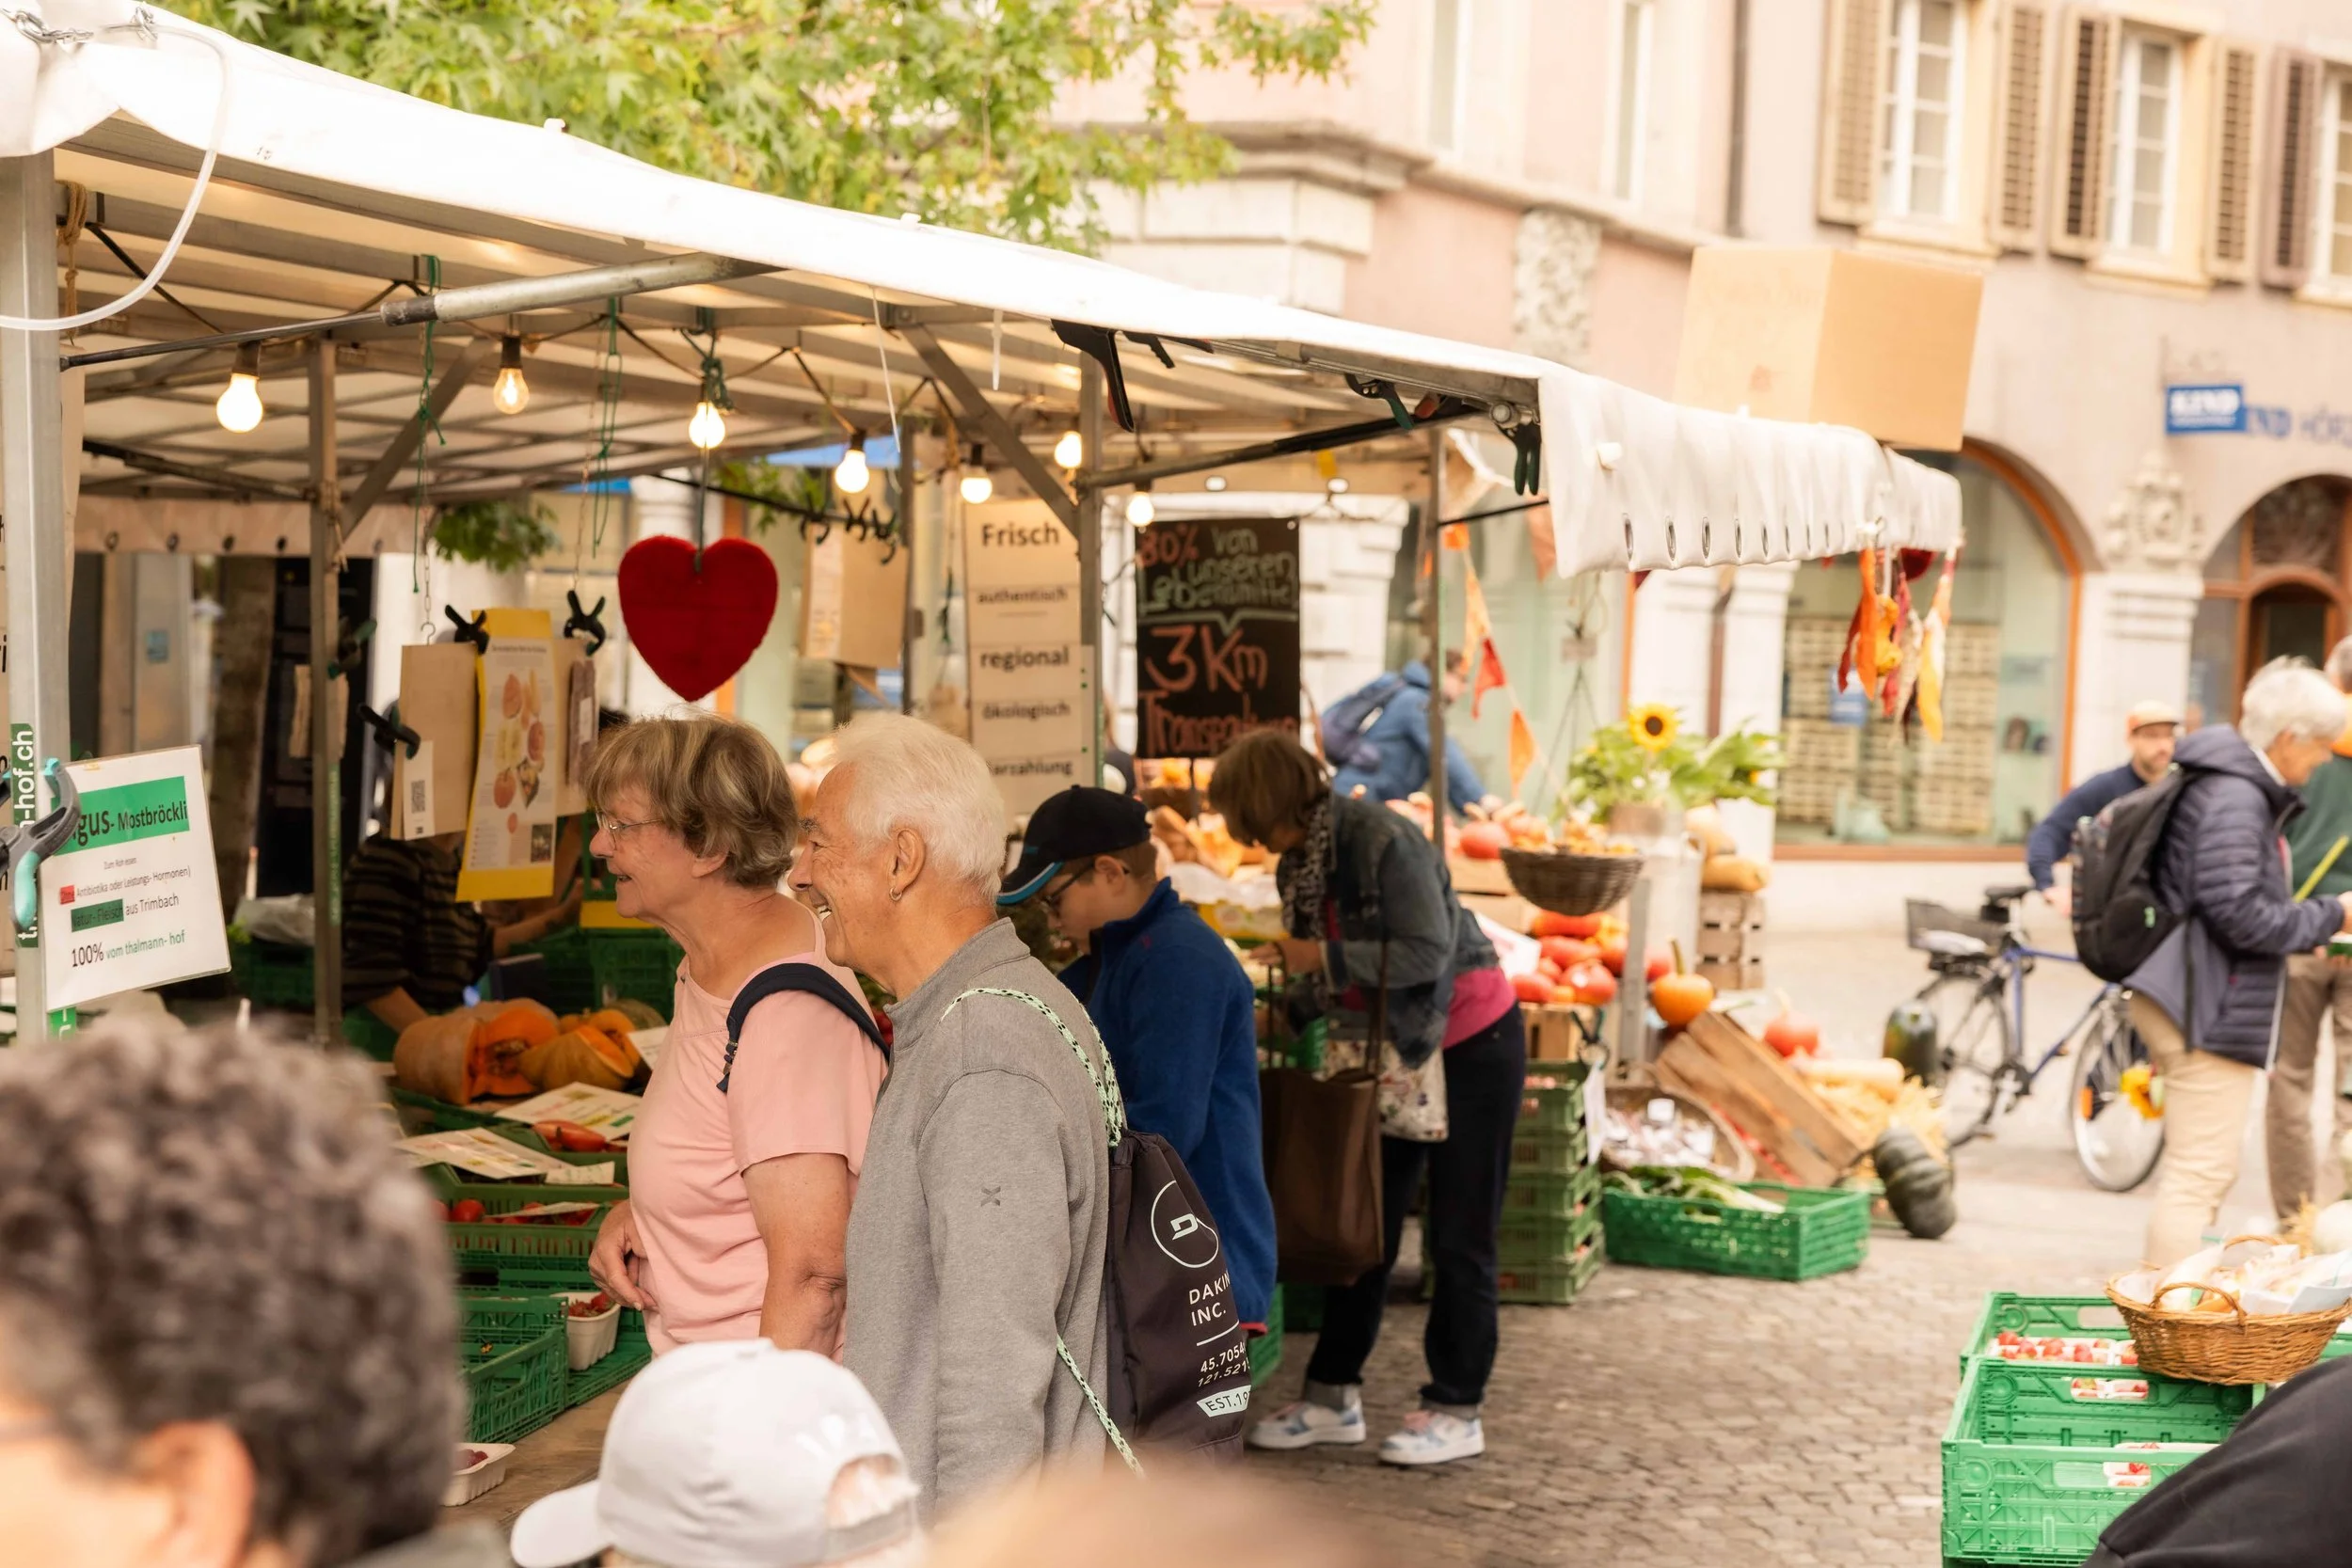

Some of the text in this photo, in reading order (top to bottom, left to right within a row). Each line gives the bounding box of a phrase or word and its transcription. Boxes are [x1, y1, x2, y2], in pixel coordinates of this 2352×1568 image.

[981, 522, 1059, 546] Frisch
[977, 586, 1068, 604] authentisch
[980, 645, 1069, 673] regional
[989, 757, 1073, 777] arzahlung
[118, 800, 188, 831] Mostbröckli
[109, 880, 123, 892] oder
[125, 905, 138, 916] aus
[140, 893, 180, 912] Trimbach
[72, 929, 185, 968] 100% vom thalmann- hof
[1189, 1268, 1231, 1306] DAKIN
[1191, 1302, 1227, 1326] INC.
[1200, 1340, 1247, 1373] 45.7054
[1205, 1389, 1250, 1412] EST.19
